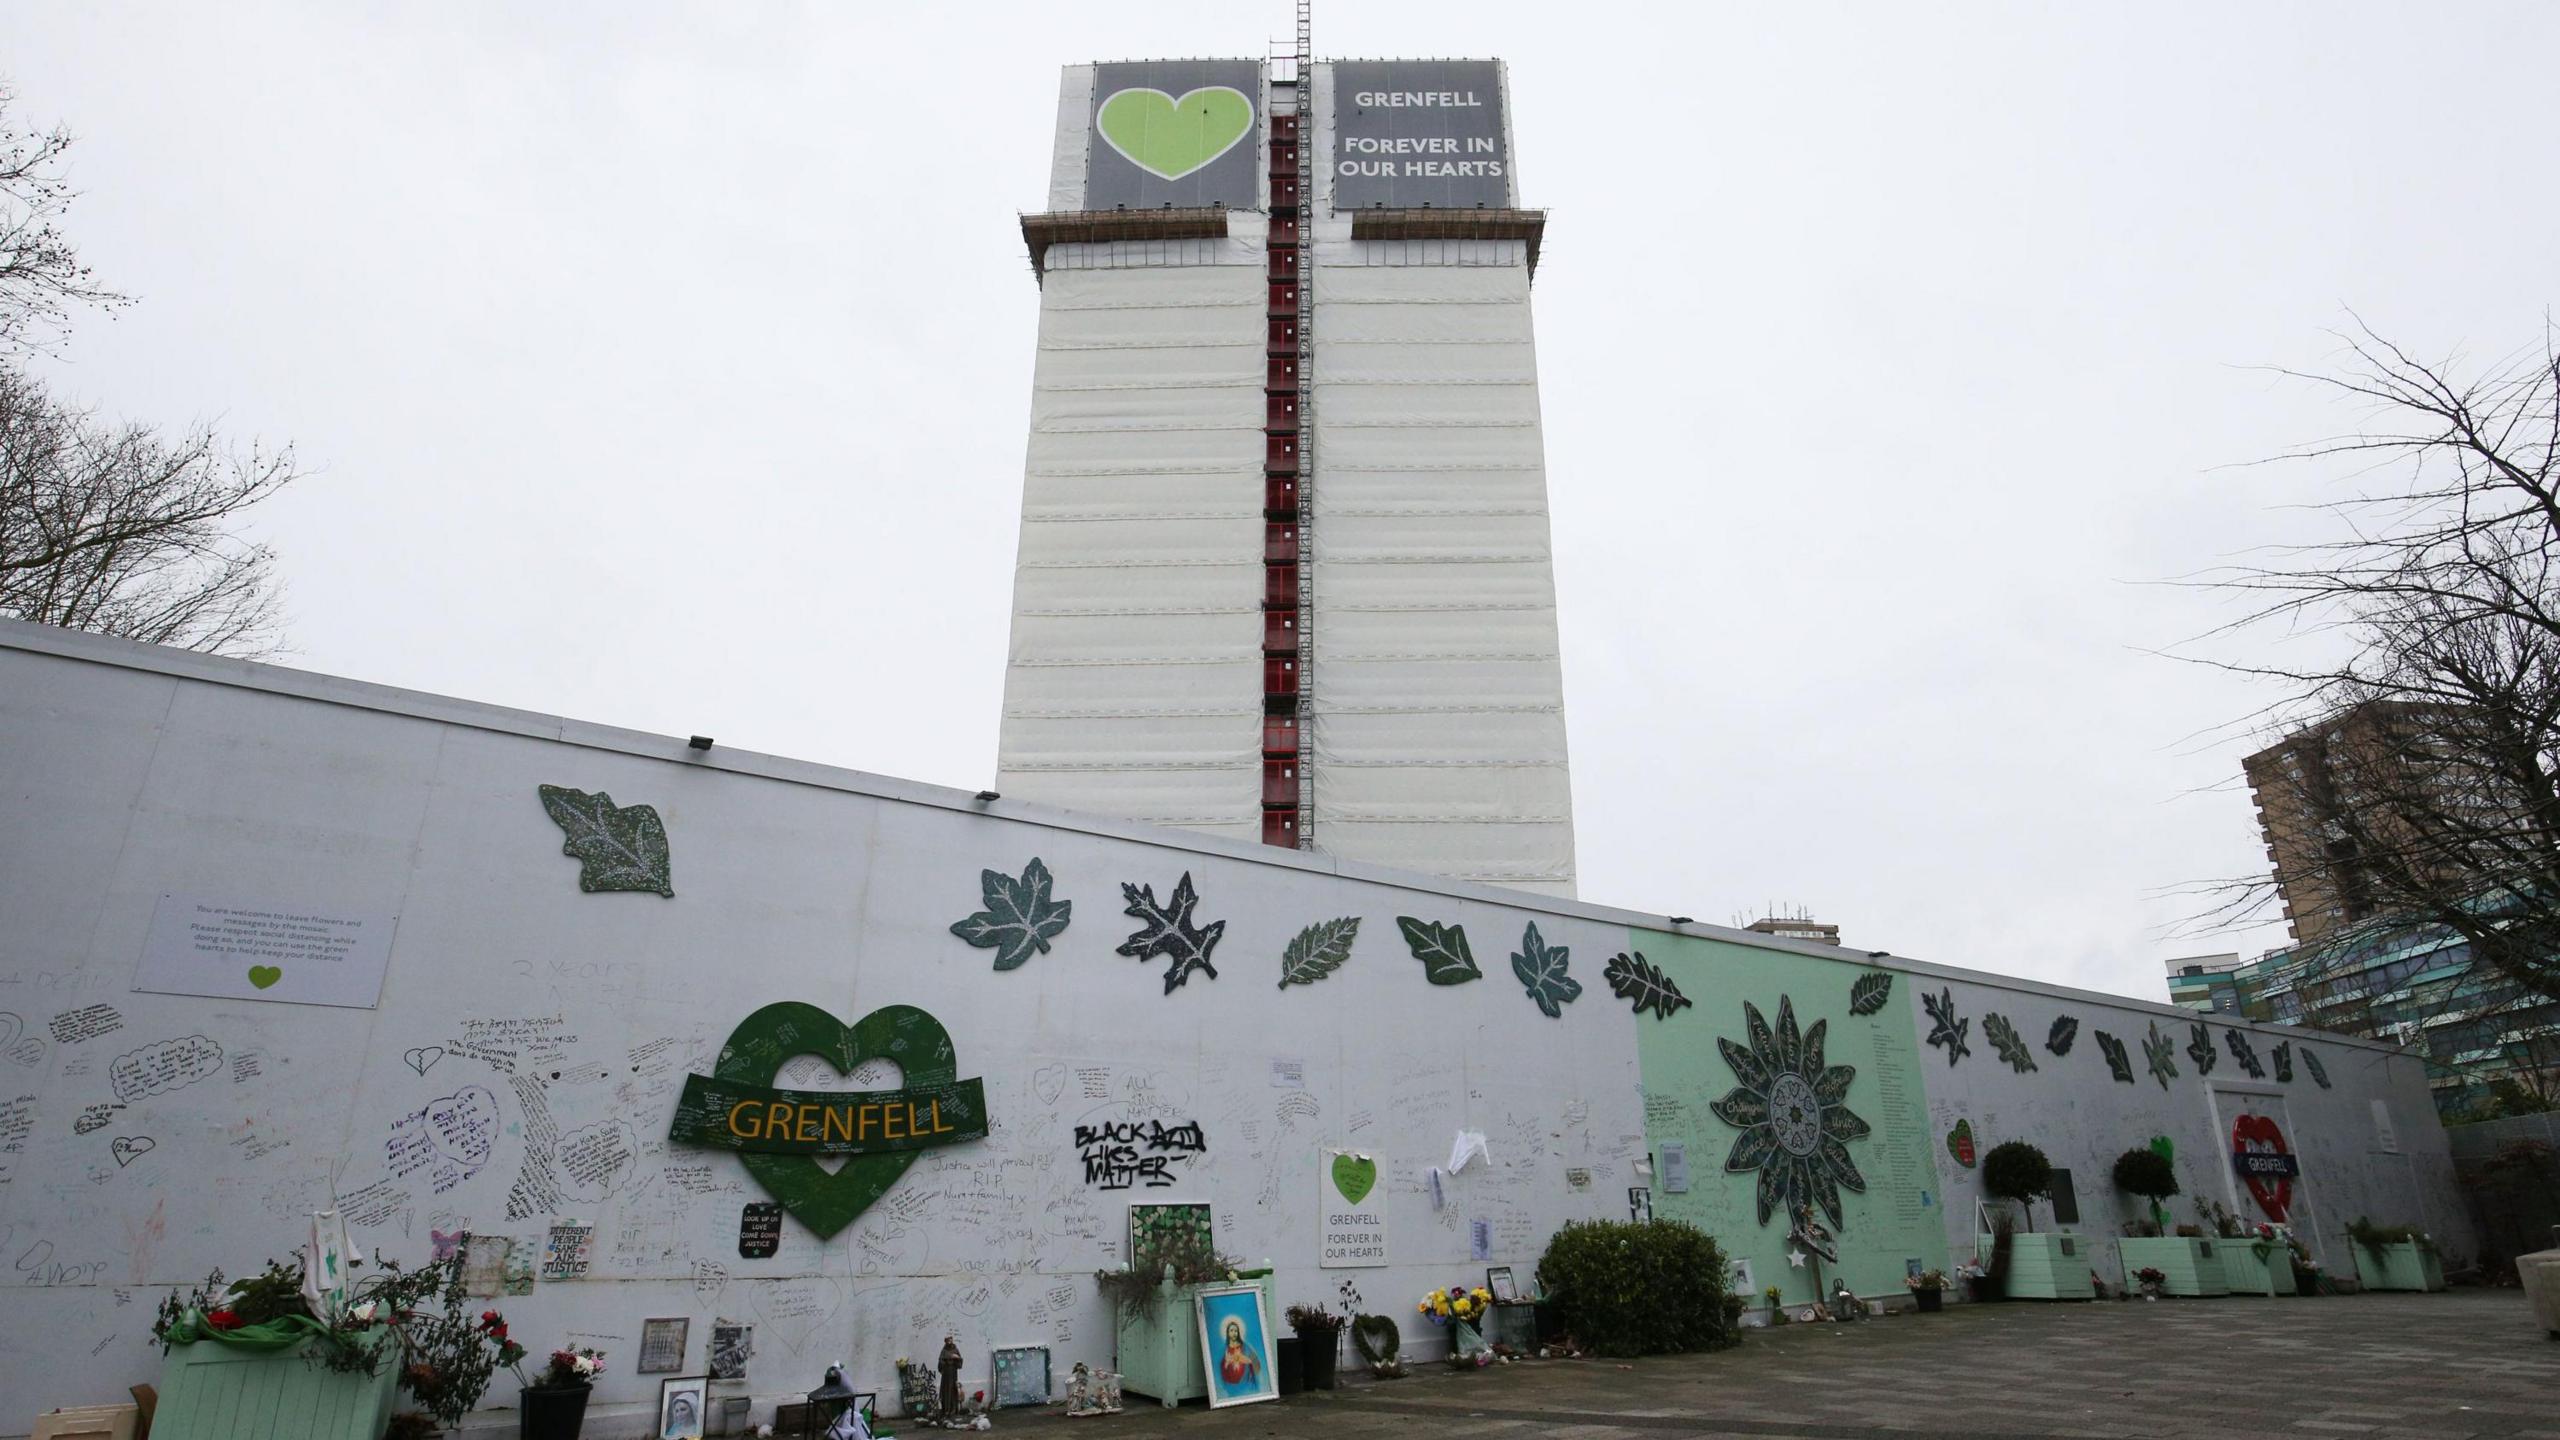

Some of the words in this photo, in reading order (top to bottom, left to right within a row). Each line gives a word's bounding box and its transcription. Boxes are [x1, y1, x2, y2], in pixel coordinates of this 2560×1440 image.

[1355, 91, 1482, 107] GRENFELL
[1345, 138, 1459, 154] FOREVER
[1468, 137, 1494, 153] IN
[1338, 161, 1398, 178] OUR
[1404, 161, 1502, 178] HEARTS
[196, 904, 212, 914] You
[213, 907, 228, 915] are
[231, 908, 271, 919] welcome
[273, 912, 284, 920] to
[286, 913, 309, 923] leave
[311, 914, 345, 926] flowers
[346, 919, 362, 928] and
[224, 917, 266, 928] messages
[269, 920, 279, 930] by
[283, 922, 297, 931] the
[190, 922, 220, 933] Please
[223, 926, 258, 938] respect
[260, 930, 285, 938] social
[288, 931, 331, 944] distancing
[333, 936, 357, 946] while
[194, 933, 218, 944] doing
[236, 937, 252, 946] and
[254, 939, 271, 949] you
[273, 940, 288, 948] can
[290, 942, 305, 950] use
[307, 943, 322, 952] the
[324, 945, 349, 954] green
[195, 943, 224, 953] hearts
[226, 945, 237, 953] to
[239, 946, 258, 956] help
[261, 948, 283, 959] keep
[284, 951, 306, 960] your
[466, 1042, 517, 1059] Government
[1807, 1036, 1821, 1069] Love
[729, 1099, 954, 1141] GRENFELL
[1074, 1121, 1148, 1149] BLACK
[928, 1155, 971, 1171] Justice
[977, 1159, 995, 1168] will
[2249, 1157, 2287, 1172] GRENFELL
[1086, 1156, 1177, 1187] MATTER
[1329, 1214, 1380, 1226] GRENFELL
[550, 1226, 592, 1235] DIFFERENT
[1327, 1233, 1369, 1244] FOREVER
[1372, 1234, 1382, 1243] IN
[553, 1236, 584, 1244] PEOPLE
[555, 1244, 578, 1252] SAME
[1325, 1248, 1346, 1259] OUR
[1349, 1247, 1384, 1258] HEARTS
[543, 1261, 589, 1273] JUSTICE
